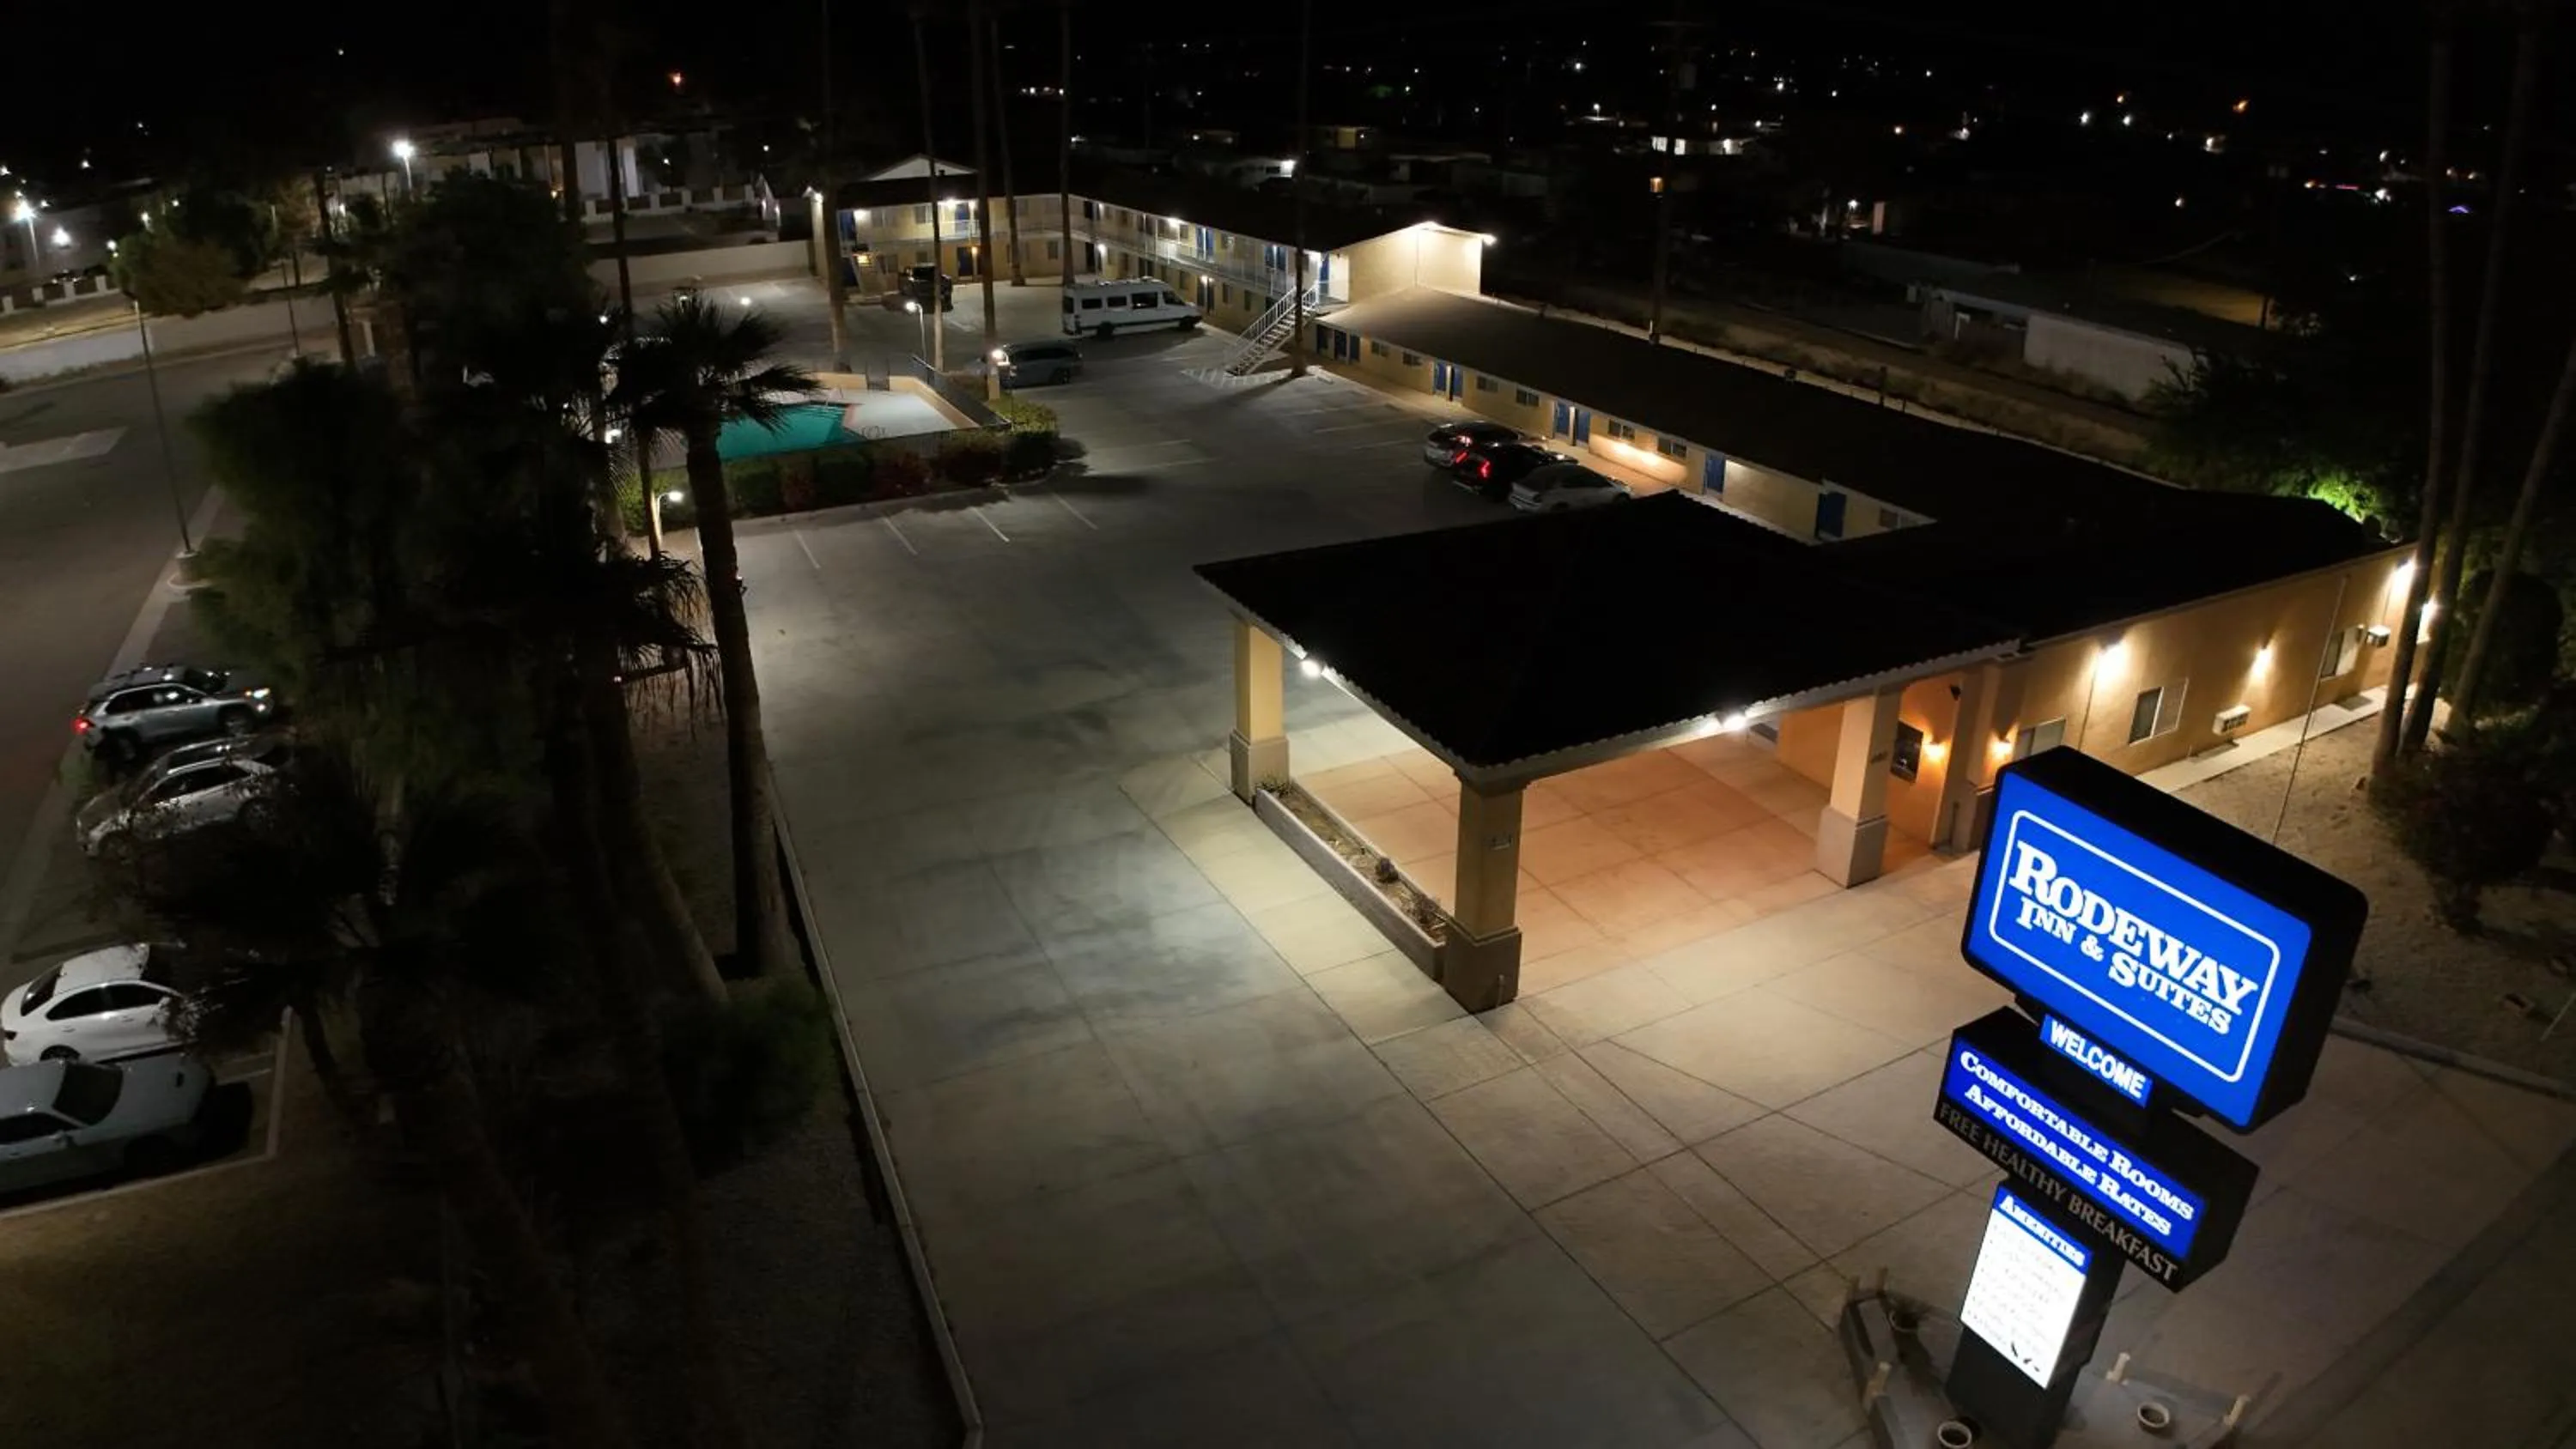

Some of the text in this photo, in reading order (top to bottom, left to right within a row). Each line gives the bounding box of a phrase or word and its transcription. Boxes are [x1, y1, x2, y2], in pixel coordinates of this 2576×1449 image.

[2010, 841, 2258, 1015] RODEWAY
[2017, 897, 2233, 1035] INN & SUITES
[1960, 1052, 2194, 1221] COMFORTABLE ROOMS
[2050, 1020, 2146, 1098] WELCOME
[1941, 1102, 2178, 1282] FREE HEALTHY BREAKFAST
[1965, 1085, 2172, 1236] AFFORDABLE RATES
